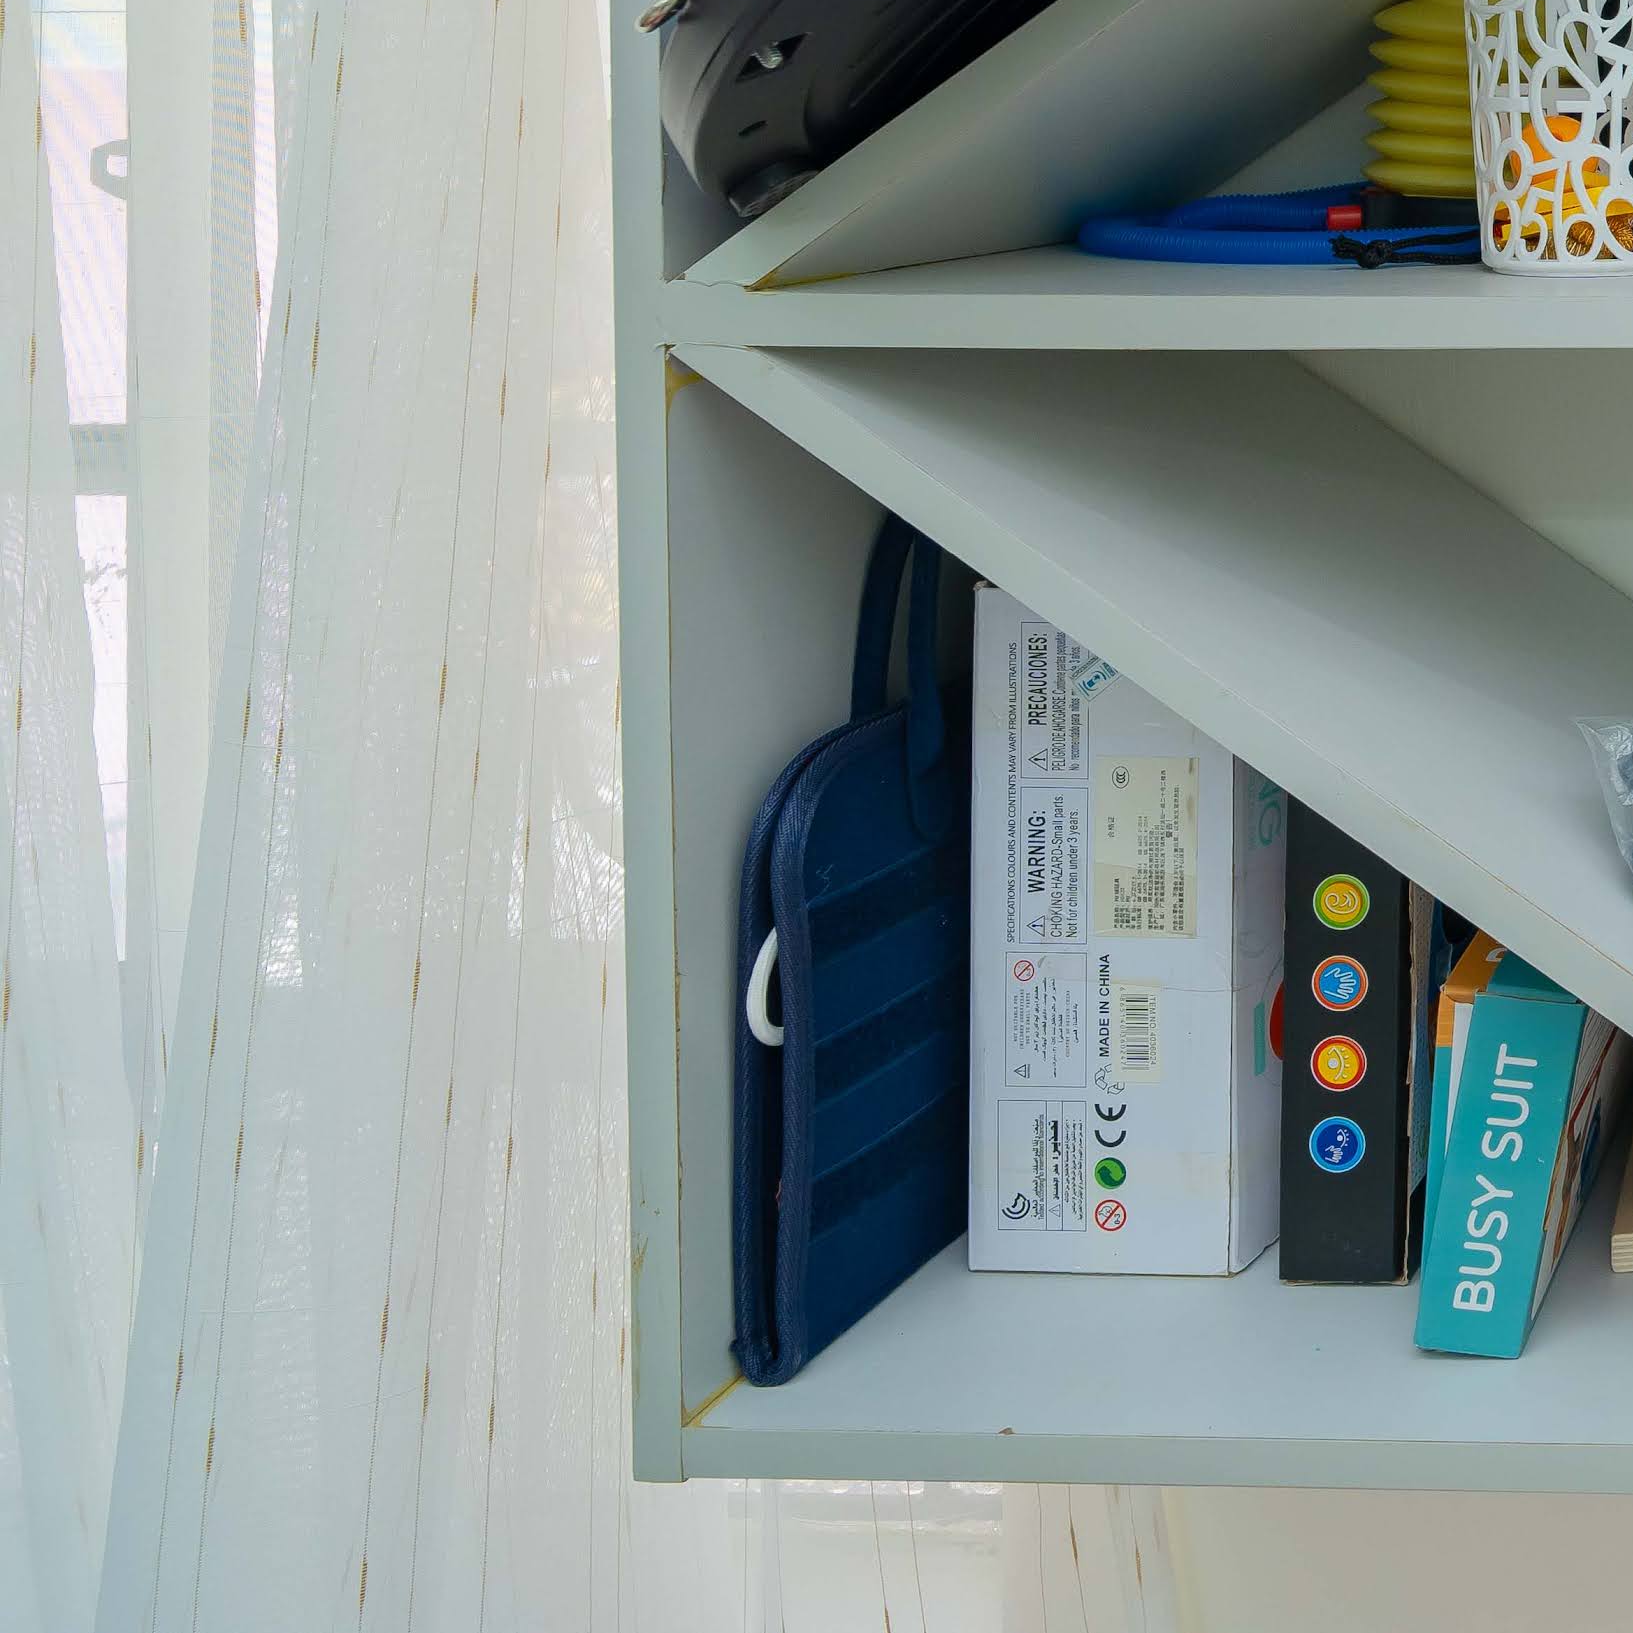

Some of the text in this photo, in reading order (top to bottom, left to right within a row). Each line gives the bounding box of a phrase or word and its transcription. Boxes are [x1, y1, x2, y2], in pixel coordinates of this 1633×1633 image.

[1028, 633, 1047, 726] PRECAUCIONES:
[1052, 732, 1066, 742] DE
[1052, 743, 1066, 771] PELIGRO
[1006, 642, 1017, 943] SPECIFICATIONS COLOURS AND CONTENTS MAY VARY FROM ILLUSTRATIONS
[1053, 793, 1065, 818] parts.
[1069, 808, 1080, 835] years.
[1027, 810, 1046, 893] WARNING:
[1066, 844, 1078, 870] under
[1066, 872, 1078, 907] children
[1051, 891, 1063, 937] CHOKING
[1066, 909, 1078, 921] for
[1066, 922, 1078, 937] Not
[1099, 954, 1110, 1057] MADE IN CHINA
[1481, 1043, 1538, 1162] SUIT
[1094, 1103, 1126, 1148] CE
[1452, 1174, 1513, 1313] BUSY
